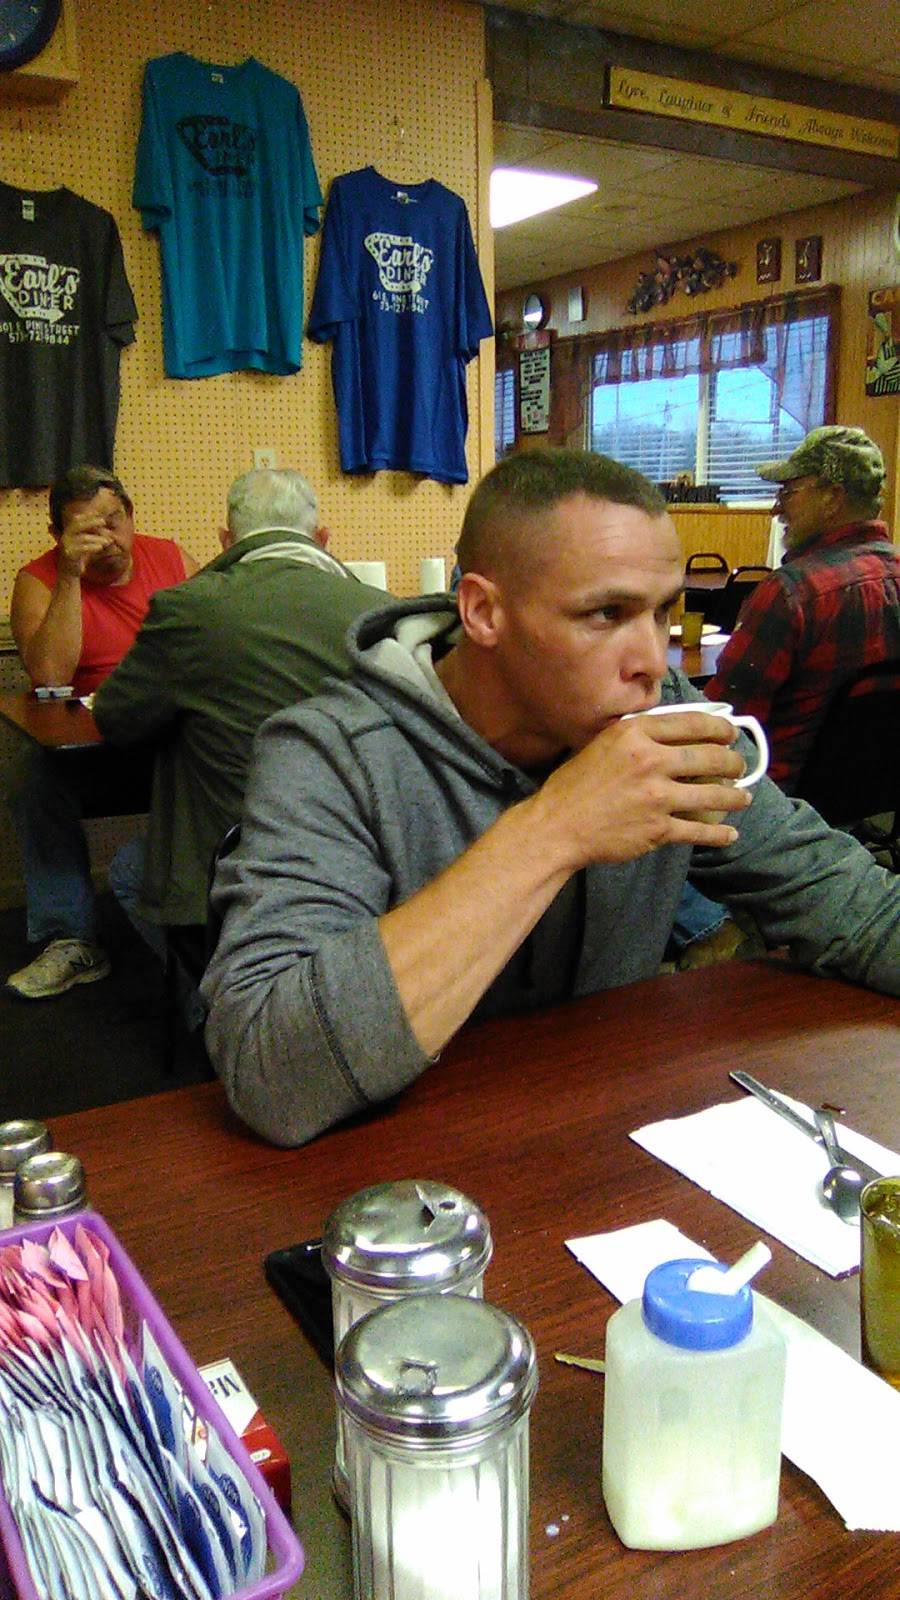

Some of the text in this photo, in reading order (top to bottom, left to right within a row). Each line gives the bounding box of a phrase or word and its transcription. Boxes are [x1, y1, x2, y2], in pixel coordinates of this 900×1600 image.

[657, 89, 713, 114] Laughter
[744, 104, 791, 129] Friends
[799, 119, 844, 142] Always
[379, 239, 434, 273] Earl's
[5, 260, 80, 295] Earl's
[386, 266, 428, 287] DINER
[19, 290, 74, 311] DINER
